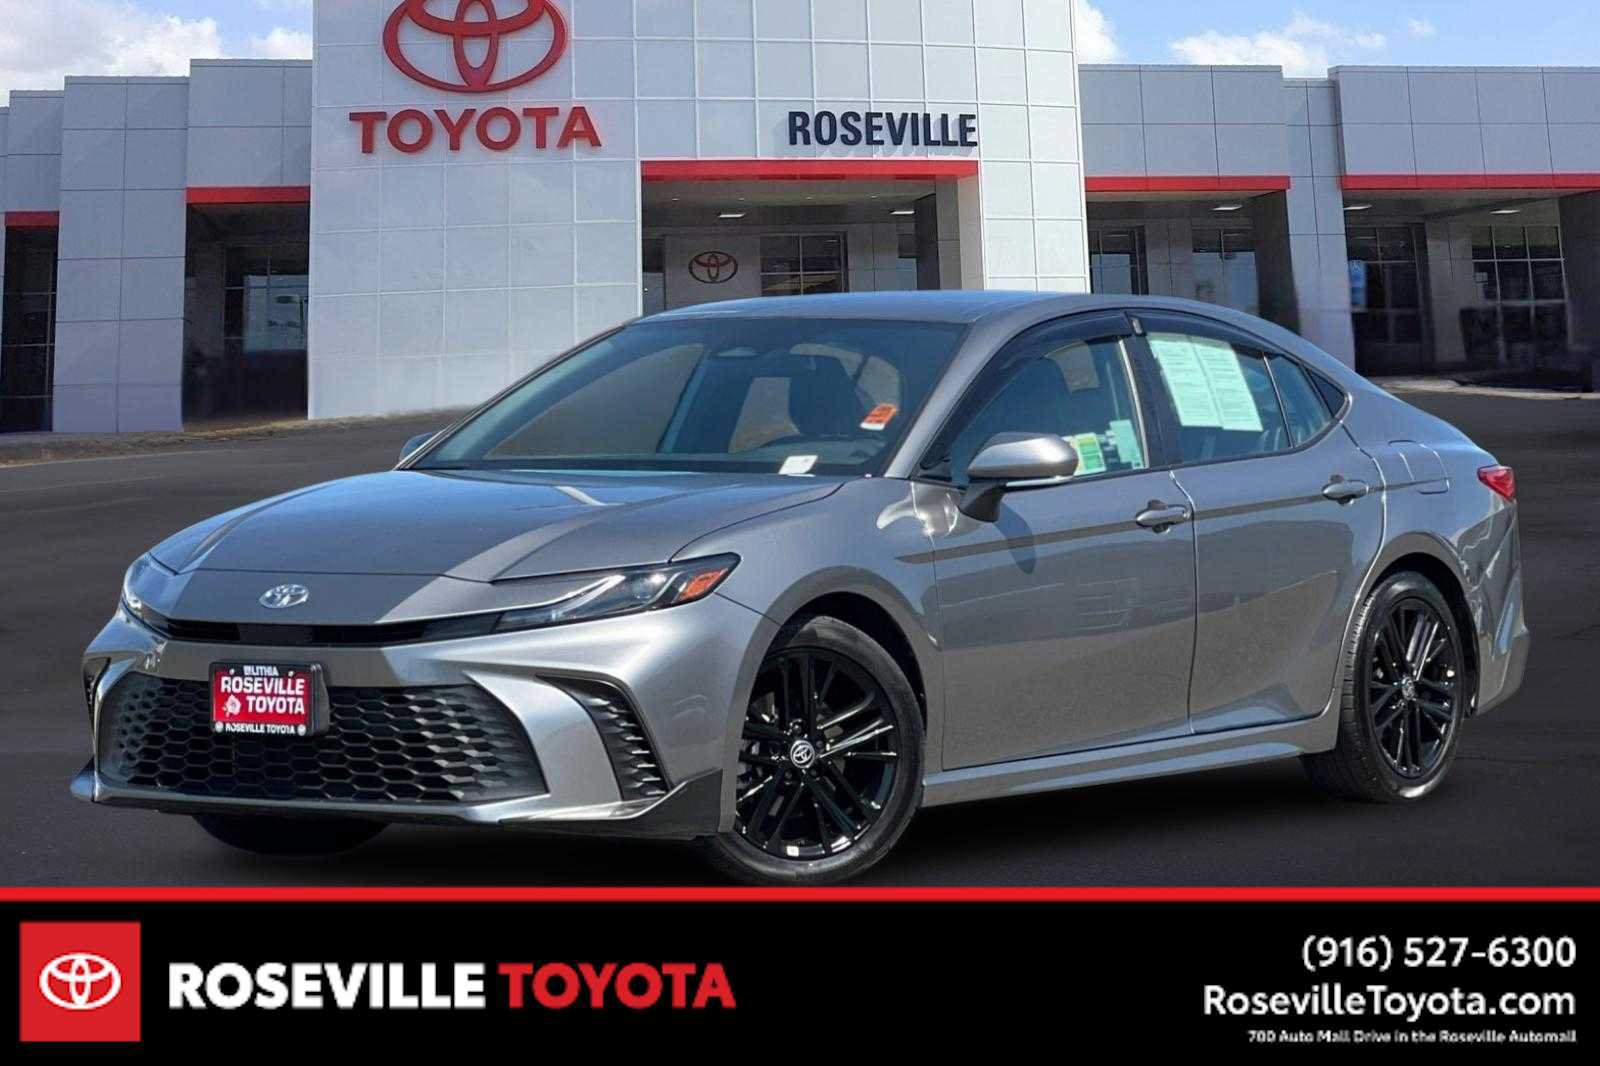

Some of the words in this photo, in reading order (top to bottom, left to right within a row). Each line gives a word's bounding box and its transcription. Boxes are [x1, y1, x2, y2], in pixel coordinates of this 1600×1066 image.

[349, 106, 602, 153] TOYOTA
[788, 110, 979, 148] ROSEVILLE
[221, 676, 304, 695] ROSEVILLE
[246, 695, 305, 714] TOYOTA
[225, 723, 265, 734] ROSEVILLE
[266, 724, 295, 734] TOYOTA
